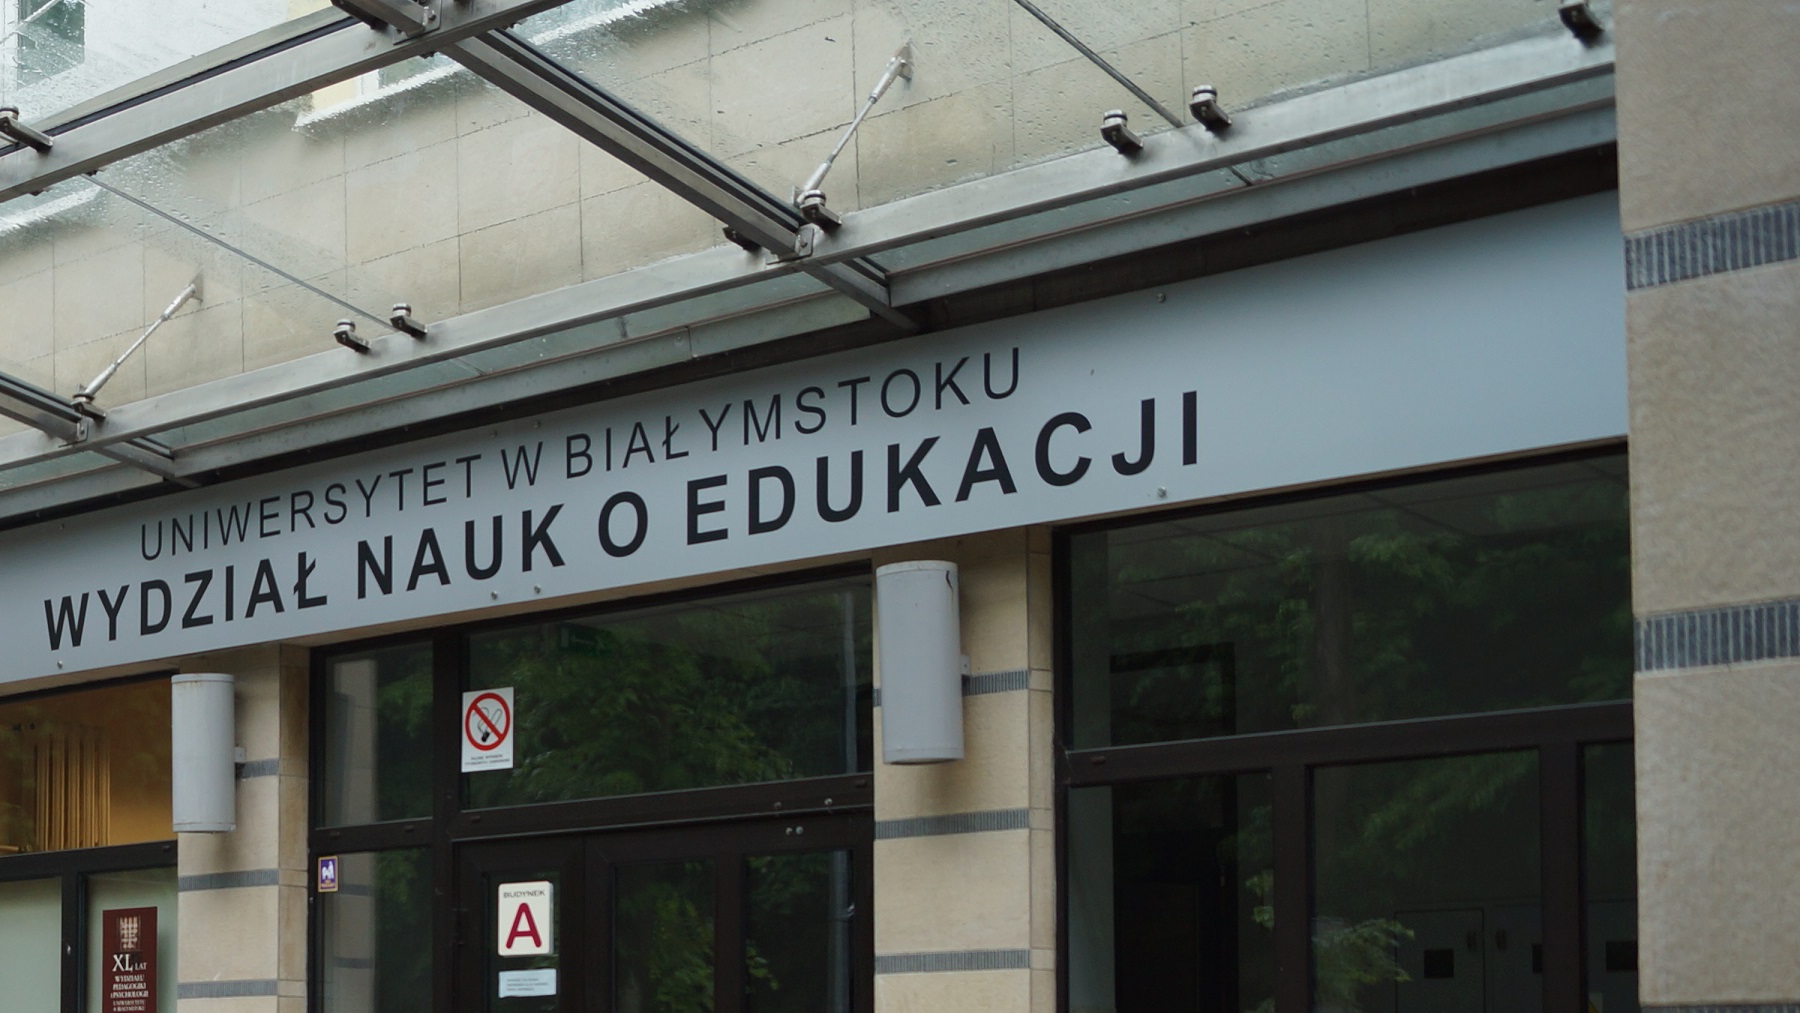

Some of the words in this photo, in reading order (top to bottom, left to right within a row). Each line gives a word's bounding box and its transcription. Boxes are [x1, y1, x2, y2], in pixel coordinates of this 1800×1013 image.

[141, 453, 482, 561] UNIWERSYTET
[500, 441, 544, 490] W
[566, 347, 1020, 479] BIAŁYMSTOKU
[44, 551, 329, 652] WYDZIAŁ
[357, 503, 567, 600] NAUK
[598, 491, 648, 558] O
[686, 390, 1198, 547] EDUKACJI
[112, 953, 133, 972] XL
[506, 902, 542, 949] A
